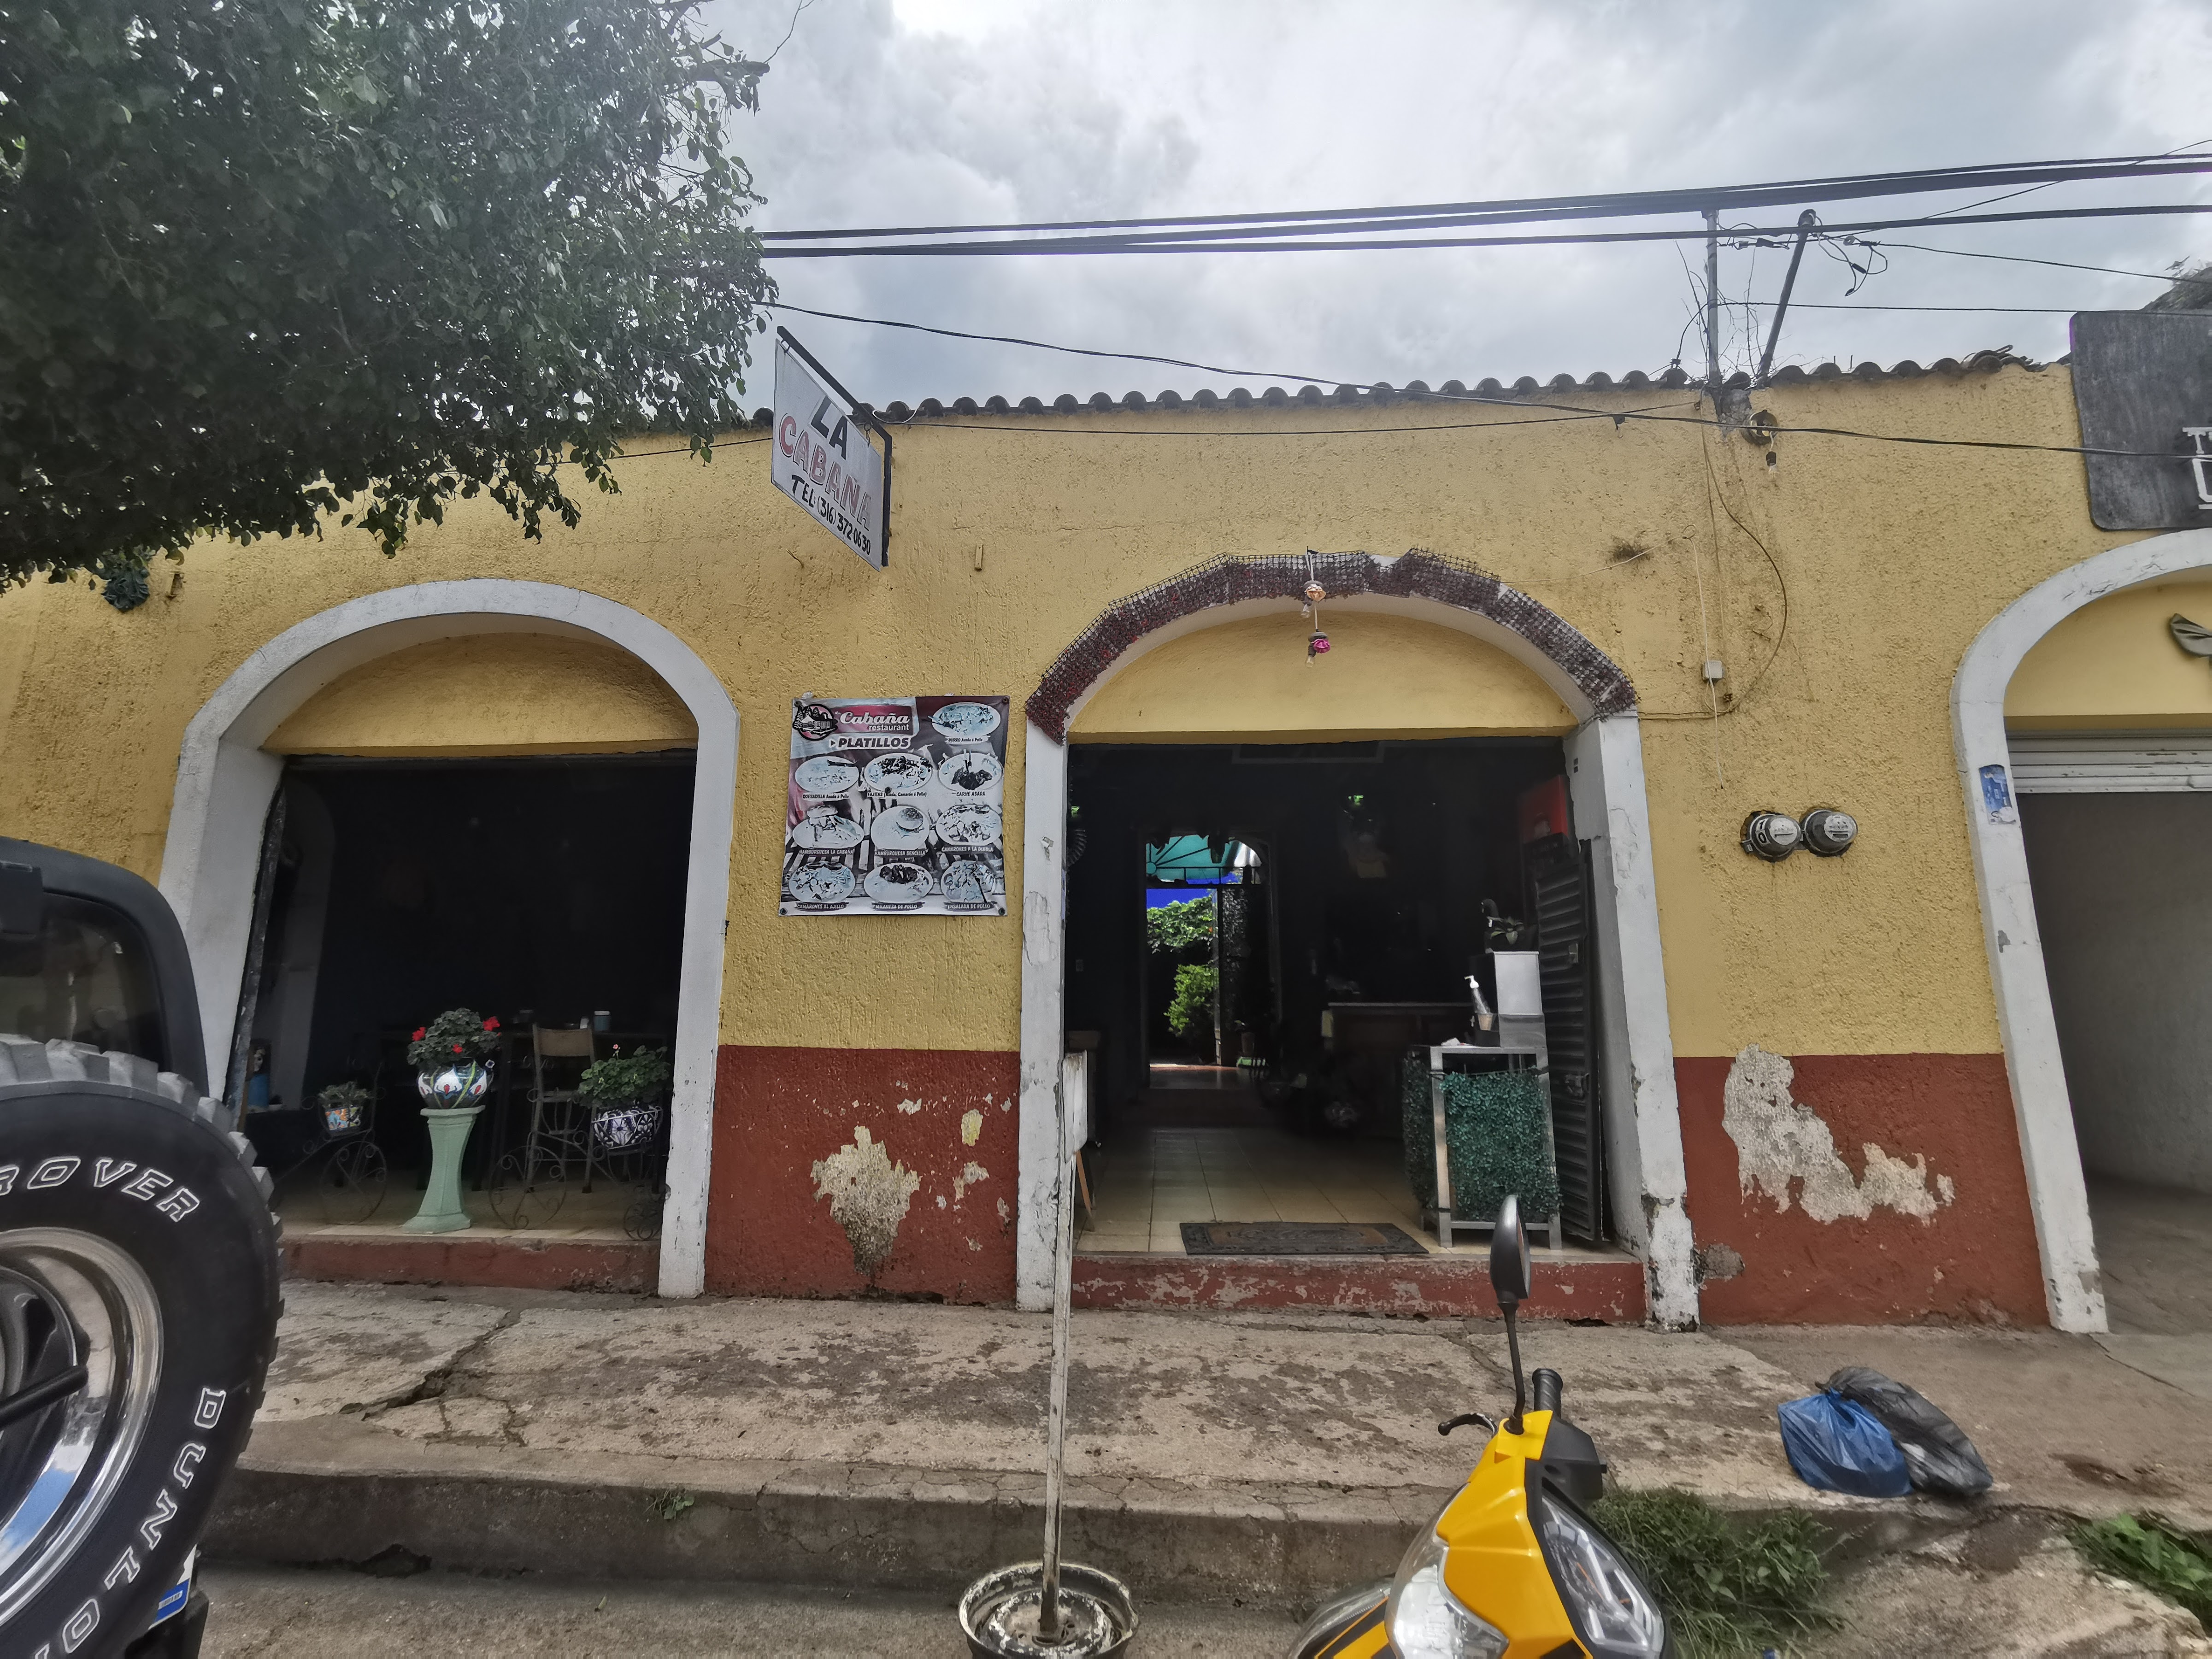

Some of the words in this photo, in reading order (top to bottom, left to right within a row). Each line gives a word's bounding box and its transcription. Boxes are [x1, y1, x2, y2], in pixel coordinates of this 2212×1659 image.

[810, 396, 848, 459] LA
[792, 475, 816, 508] TEL:
[818, 495, 836, 524] (316)
[838, 738, 909, 747] PLATILLOS
[840, 712, 910, 724] Cabaña
[35, 1388, 226, 1659] DUNLO
